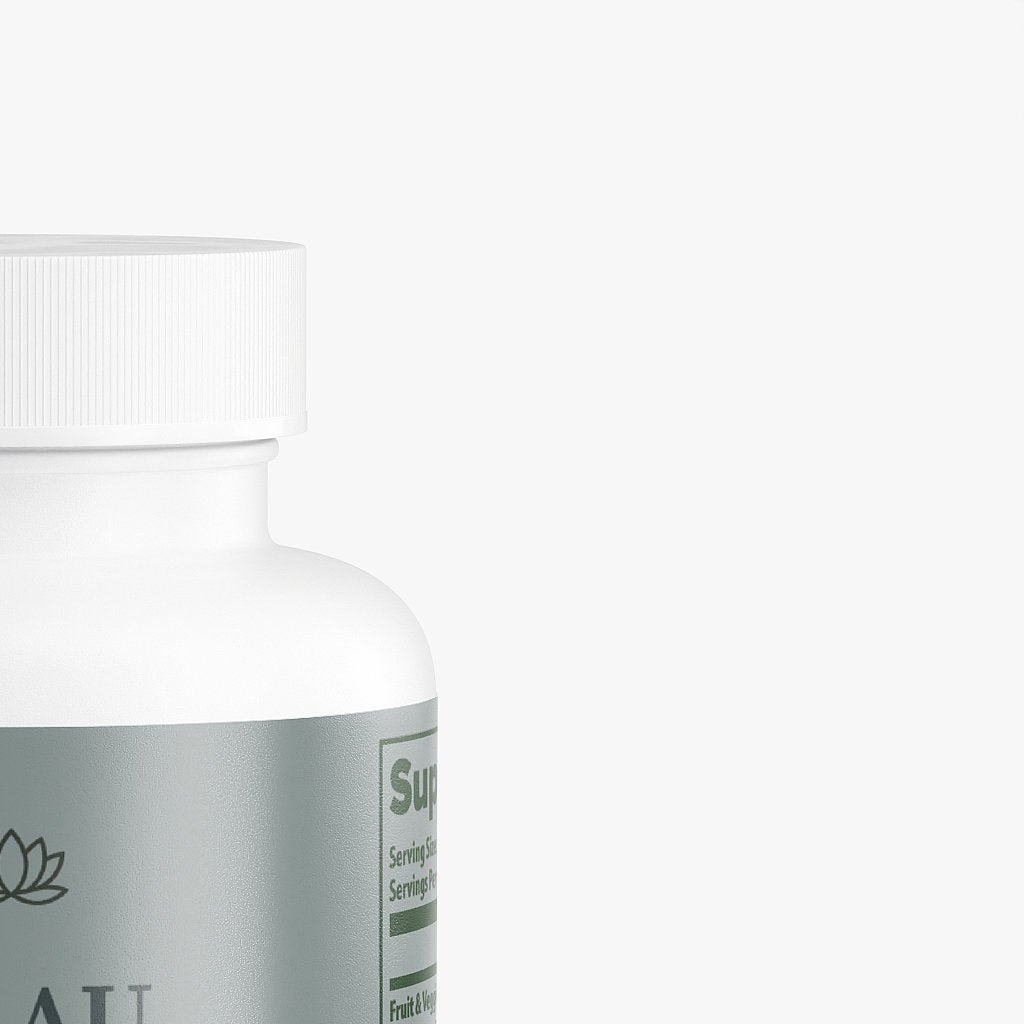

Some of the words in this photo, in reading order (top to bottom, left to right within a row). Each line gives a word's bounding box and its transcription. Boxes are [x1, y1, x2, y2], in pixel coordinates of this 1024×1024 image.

[389, 841, 425, 868] Serving
[389, 874, 428, 901] Servings
[390, 996, 414, 1022] Fruit
[415, 993, 422, 1015] &
